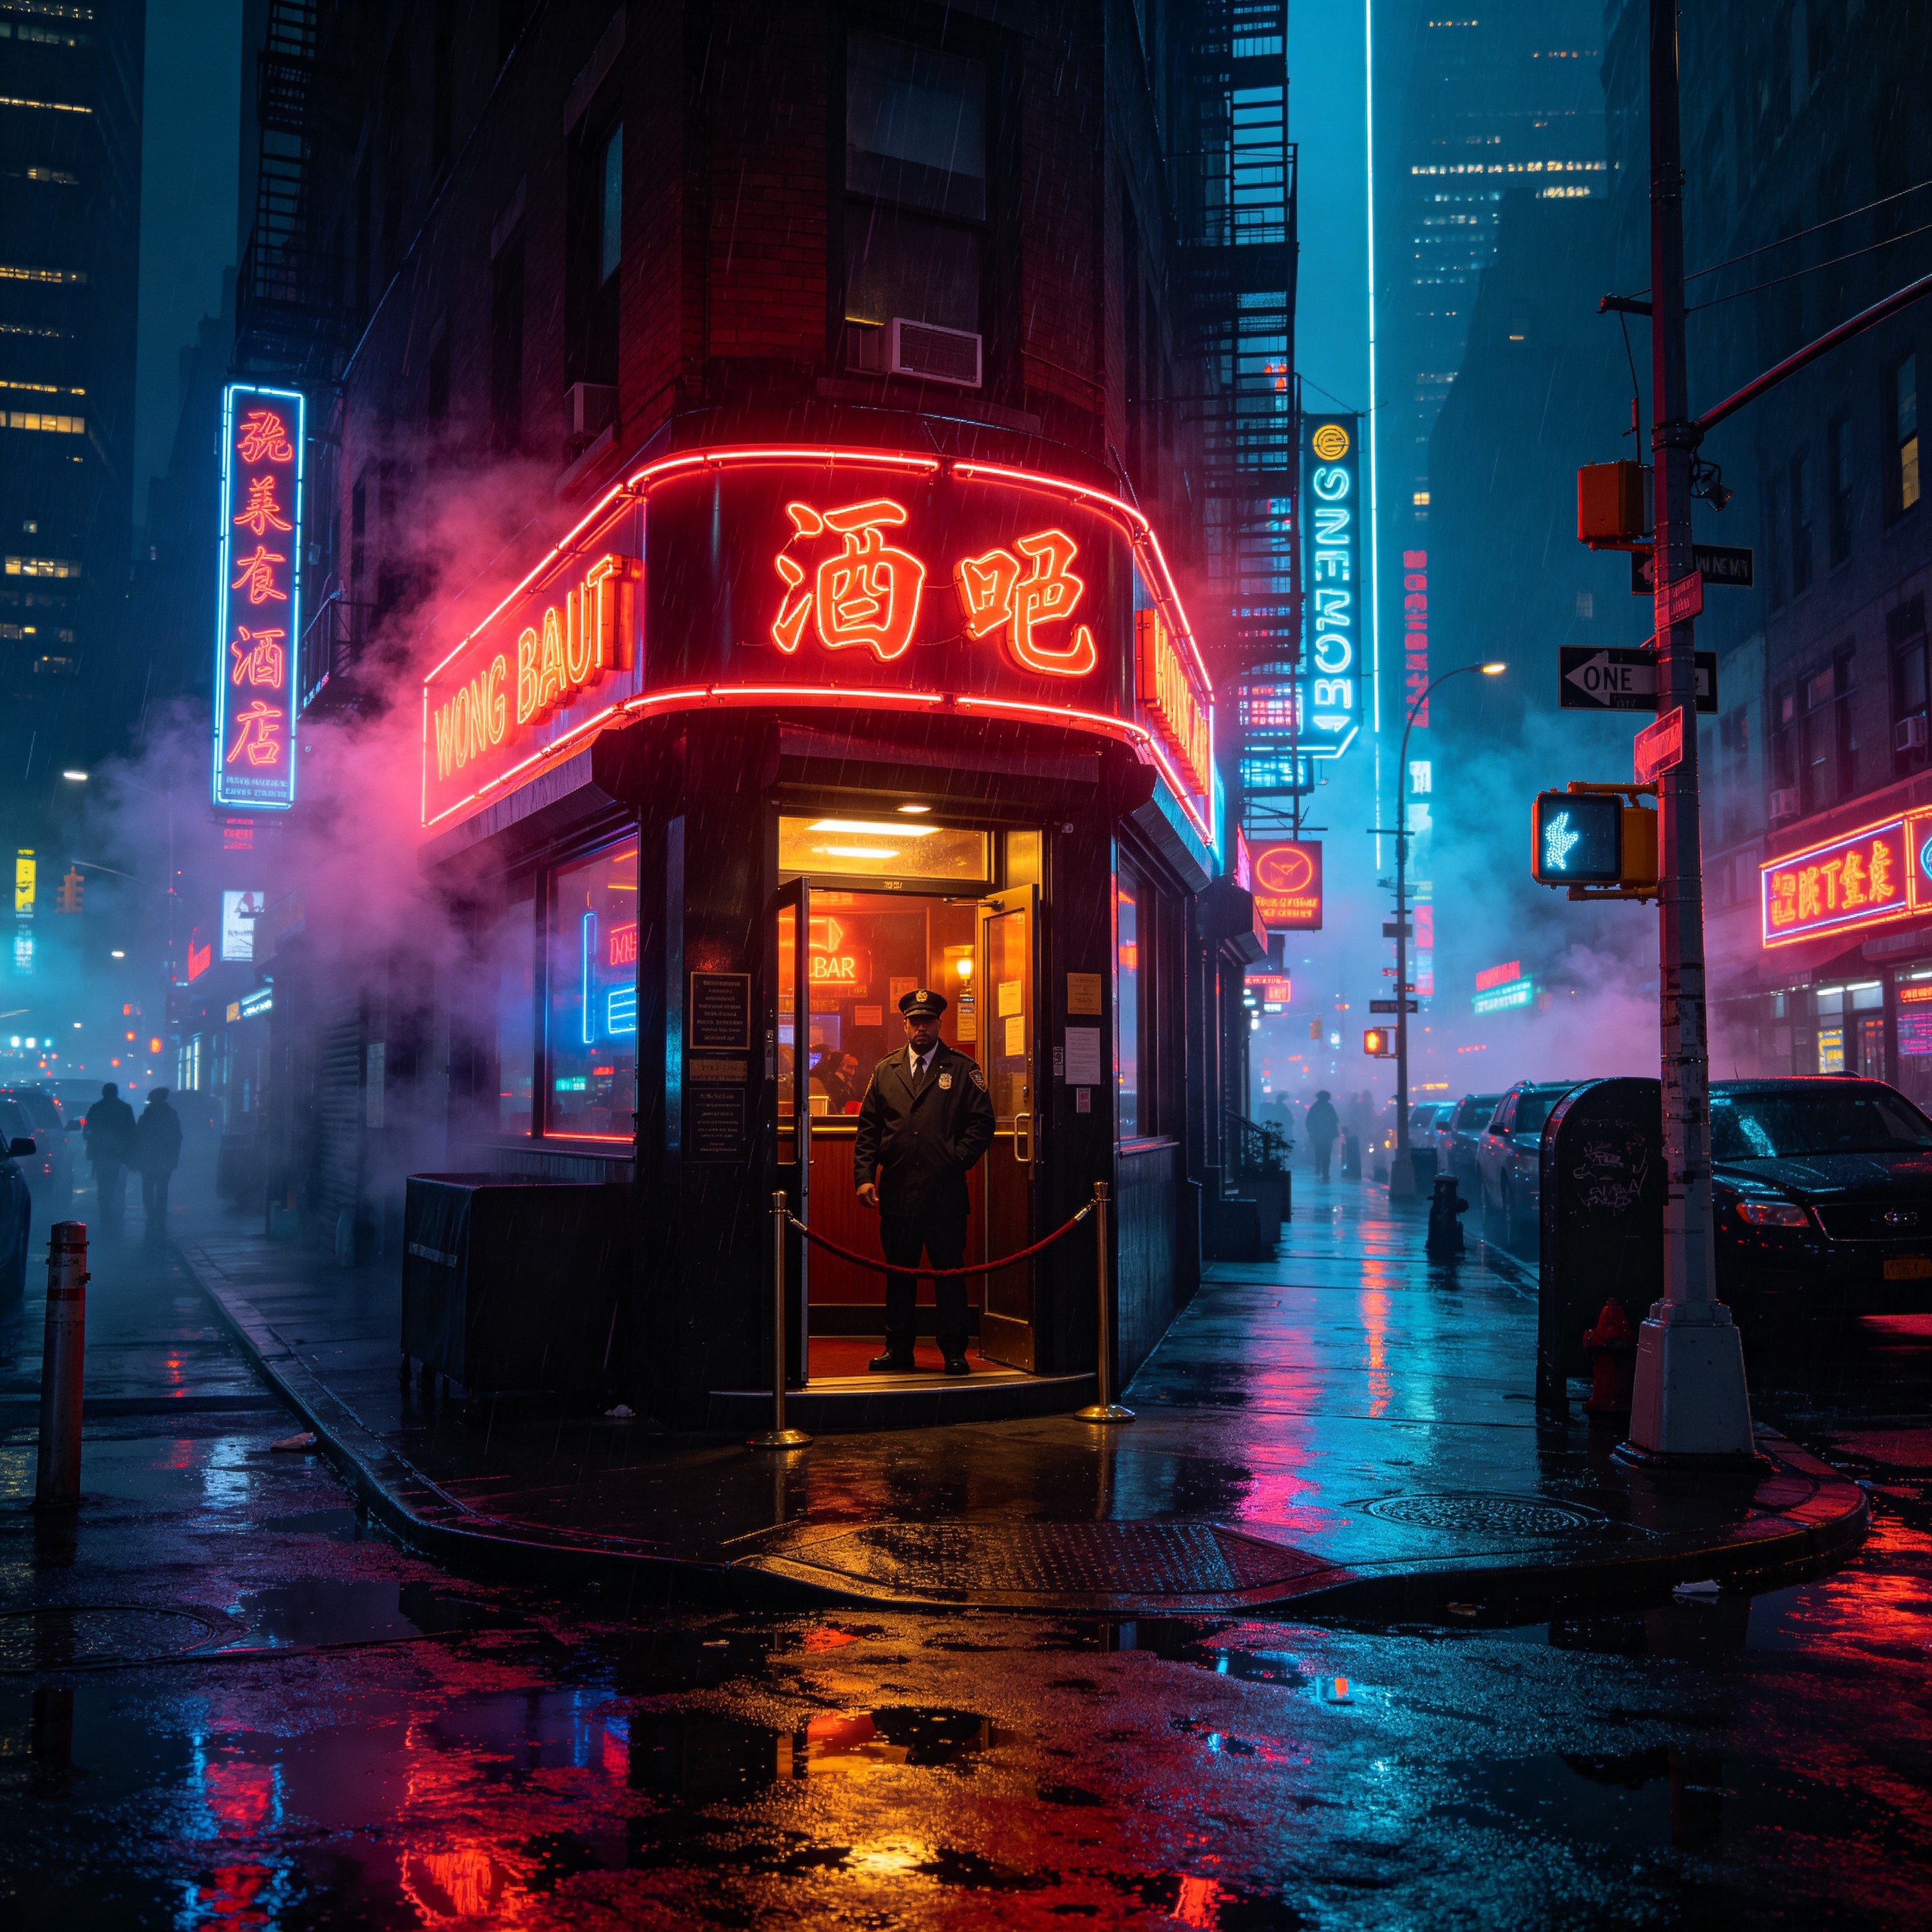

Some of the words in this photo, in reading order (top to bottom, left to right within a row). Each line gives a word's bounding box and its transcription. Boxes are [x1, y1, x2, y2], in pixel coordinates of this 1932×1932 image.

[772, 498, 1097, 676] 酒吧
[435, 654, 506, 781] WONG
[516, 553, 616, 726] BAUT
[1584, 665, 1633, 692] ONE
[815, 956, 855, 978] BAR
